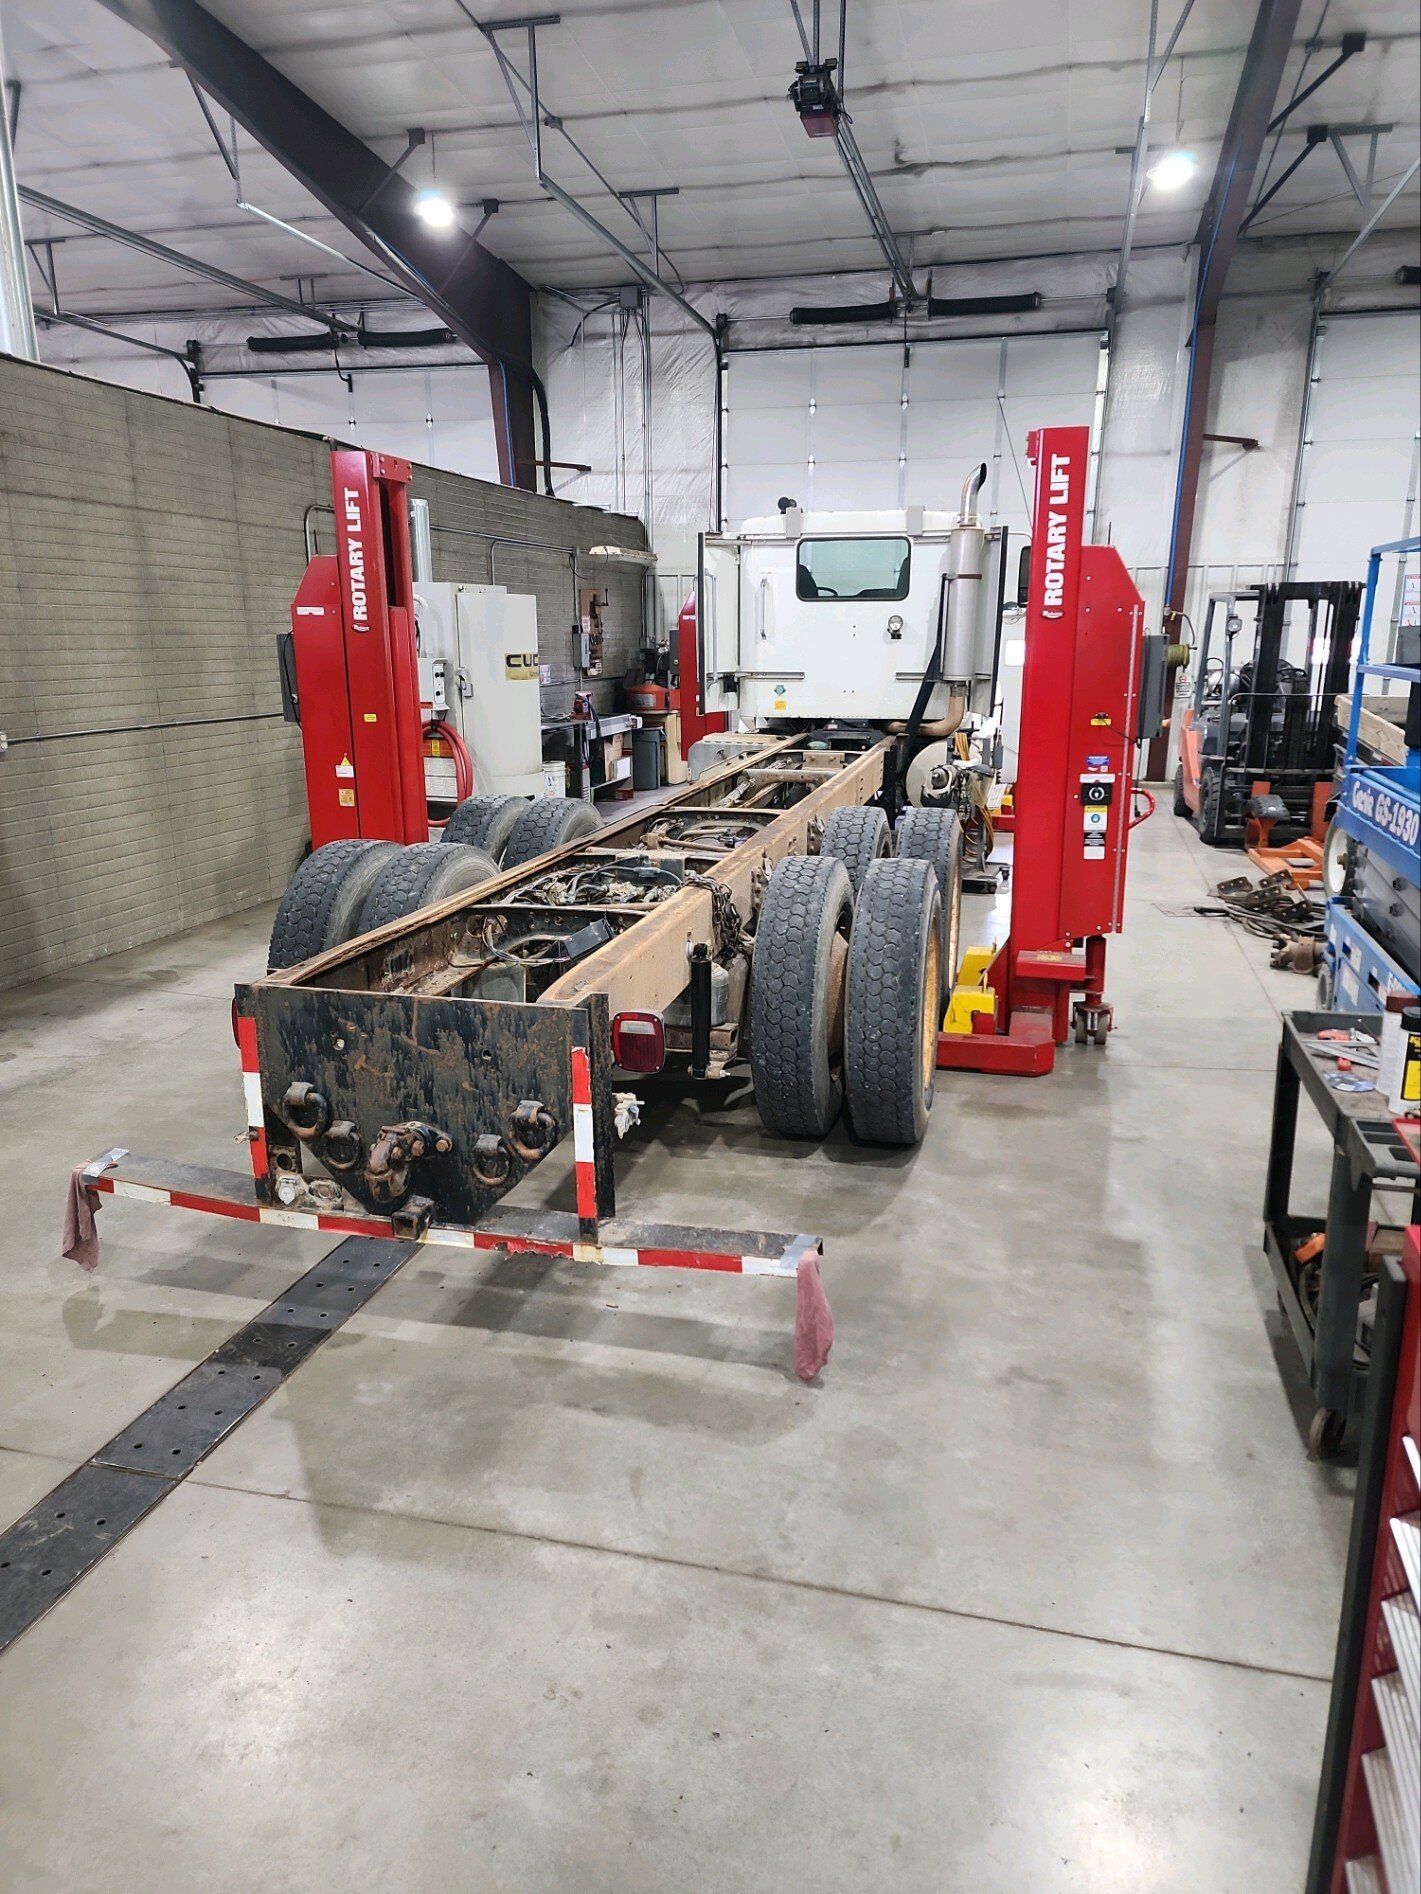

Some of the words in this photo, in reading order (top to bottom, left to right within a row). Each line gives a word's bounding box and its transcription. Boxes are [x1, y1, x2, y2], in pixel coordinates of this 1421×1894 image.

[1049, 454, 1071, 504] LIFT
[344, 487, 362, 532] LIFT
[348, 538, 368, 621] ROTARY
[1044, 511, 1068, 606] ROTARY
[1375, 793, 1420, 846] GS-1930
